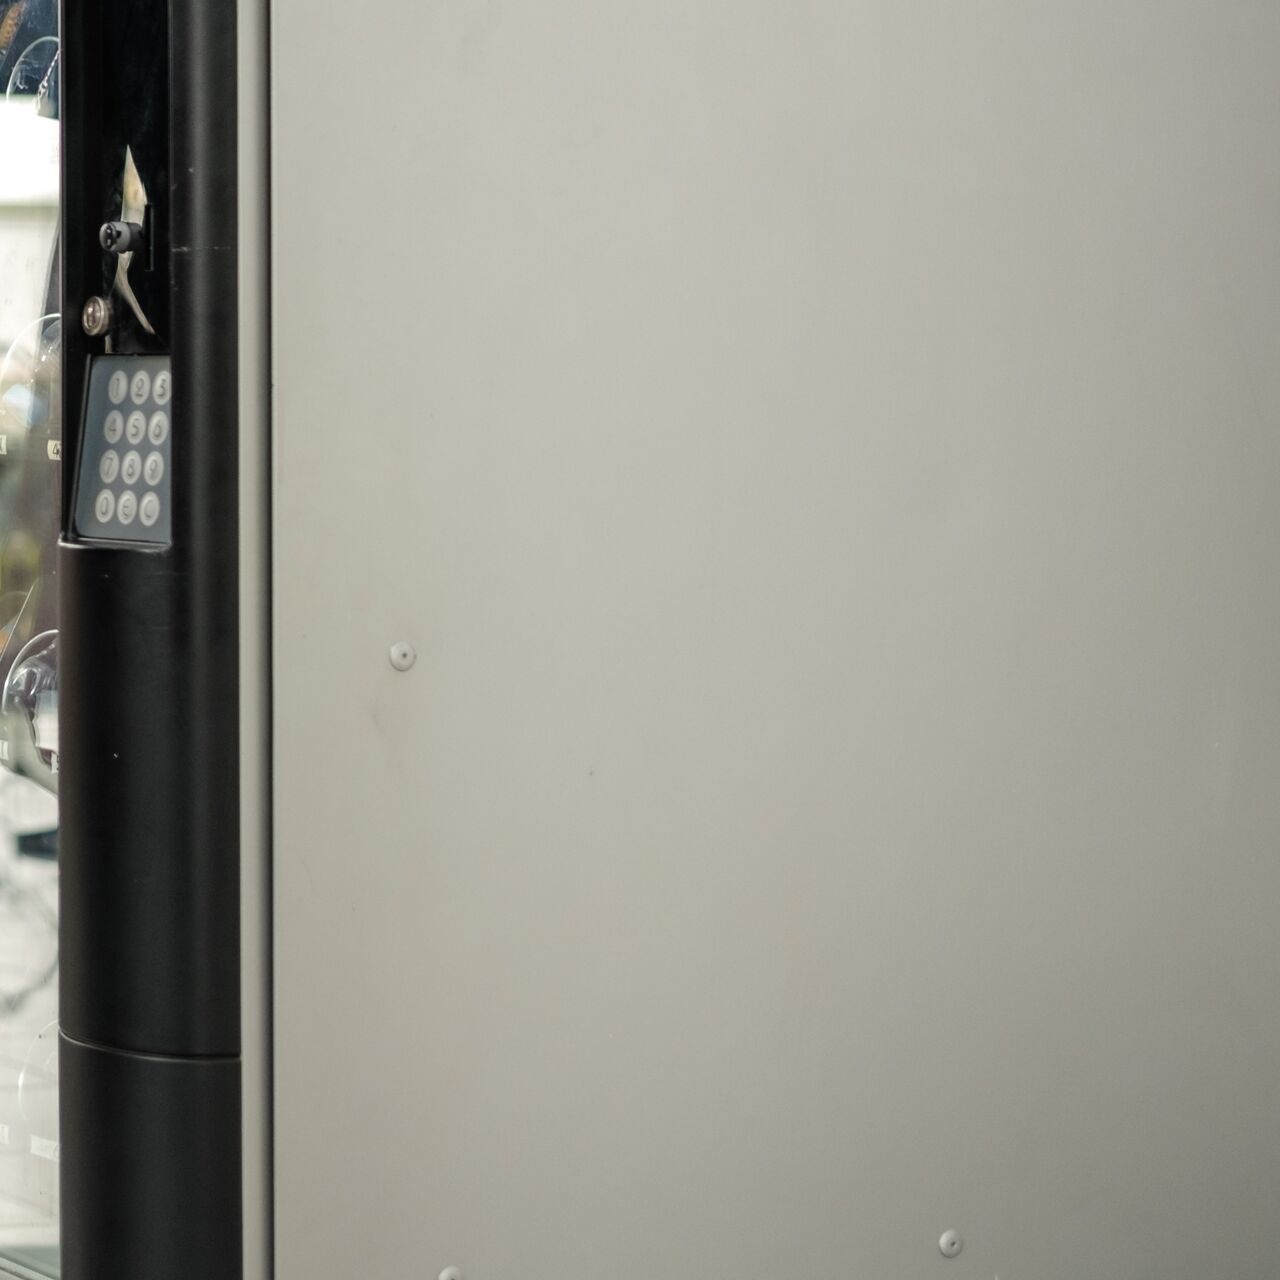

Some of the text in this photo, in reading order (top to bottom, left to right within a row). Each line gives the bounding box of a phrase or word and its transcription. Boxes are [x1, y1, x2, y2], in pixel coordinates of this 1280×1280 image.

[135, 377, 145, 398] 2
[157, 378, 167, 398] 3
[108, 417, 163, 439] 4 5 6
[104, 456, 158, 479] 7 8 9
[100, 495, 109, 517] 0
